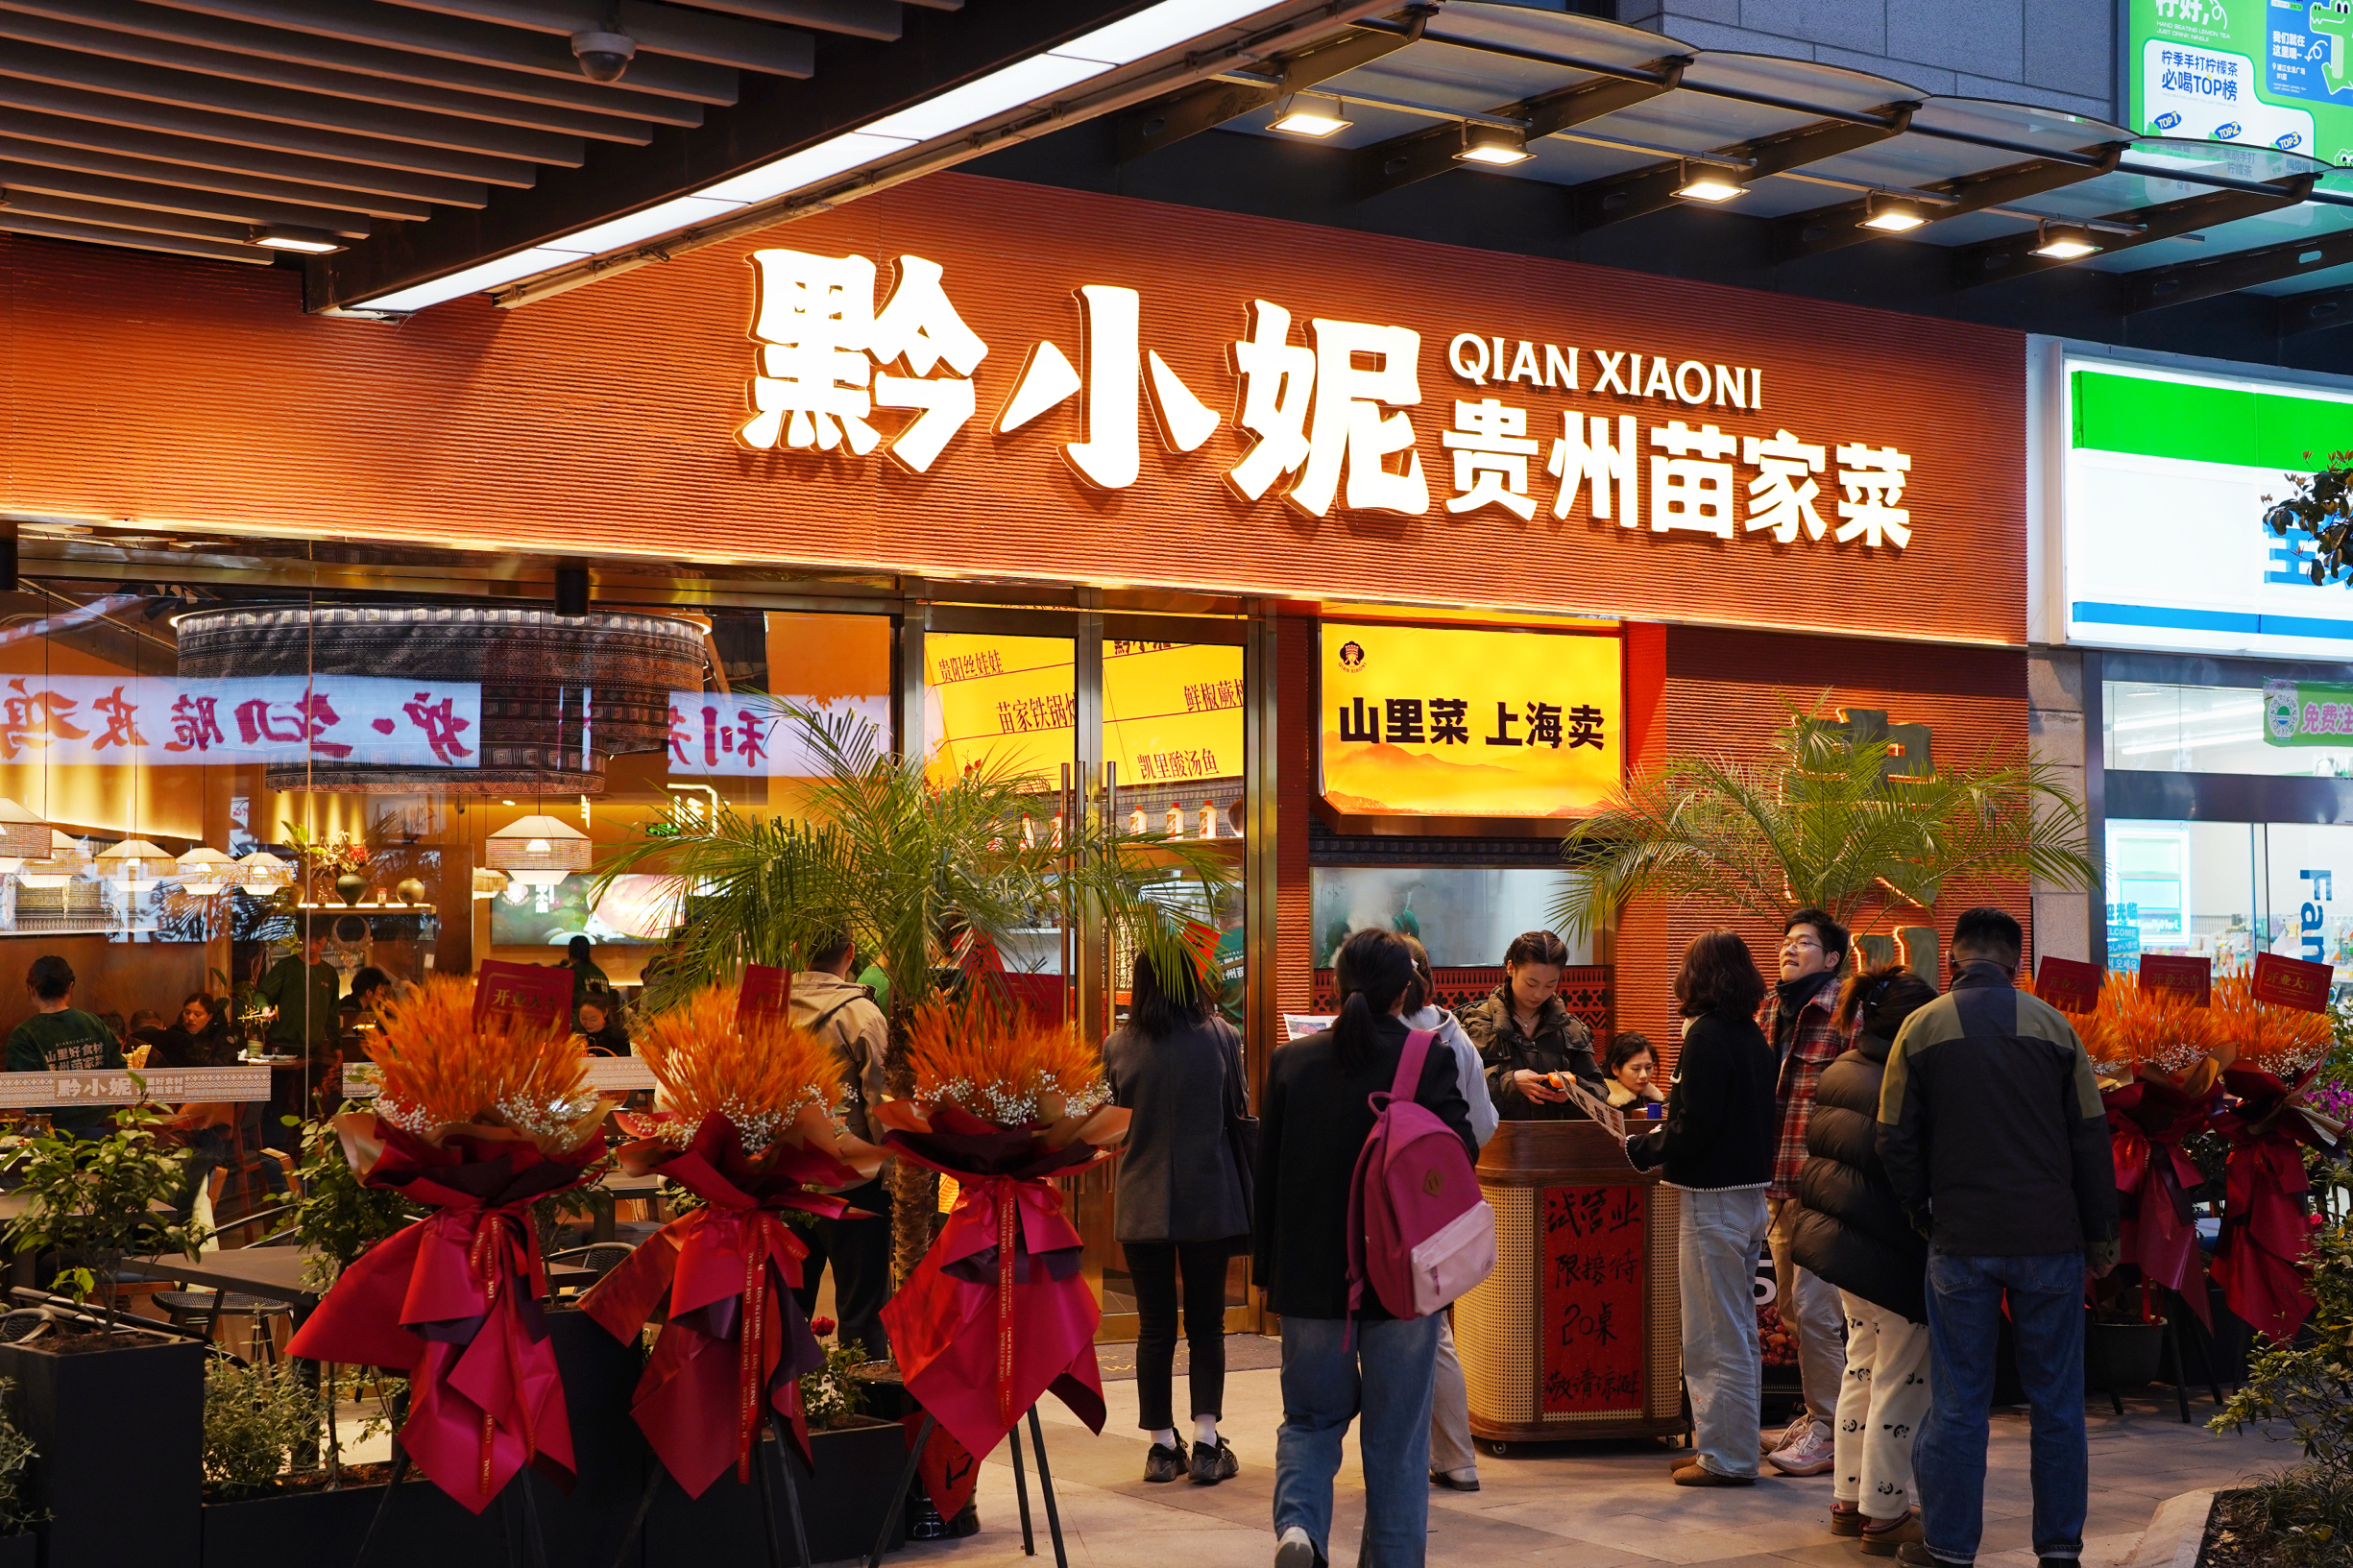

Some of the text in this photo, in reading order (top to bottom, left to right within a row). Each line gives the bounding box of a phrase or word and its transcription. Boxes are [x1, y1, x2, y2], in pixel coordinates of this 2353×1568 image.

[2272, 30, 2305, 47] 我们就在
[2161, 50, 2238, 78] 柠季手打柠檬茶
[2162, 69, 2238, 102] 必喝TOP榜
[733, 248, 1430, 519] 黔小妮
[1444, 332, 1763, 410] QIAN XIAONI
[1442, 398, 1913, 550] 贵州苗家菜
[938, 648, 1005, 684] 贵阳丝娃娃
[1339, 696, 1605, 751] 山里菜 上海卖
[1137, 747, 1221, 781] 凯里酸汤鱼
[45, 1042, 105, 1063] 山里好食材
[57, 1077, 133, 1098] 黔小妮
[145, 1076, 183, 1086] 里好食材
[1546, 1188, 1641, 1238] 试营业
[1555, 1247, 1639, 1290] 限接待
[1562, 1300, 1618, 1346] 20桌
[1545, 1364, 1640, 1405] 敬请谅解
